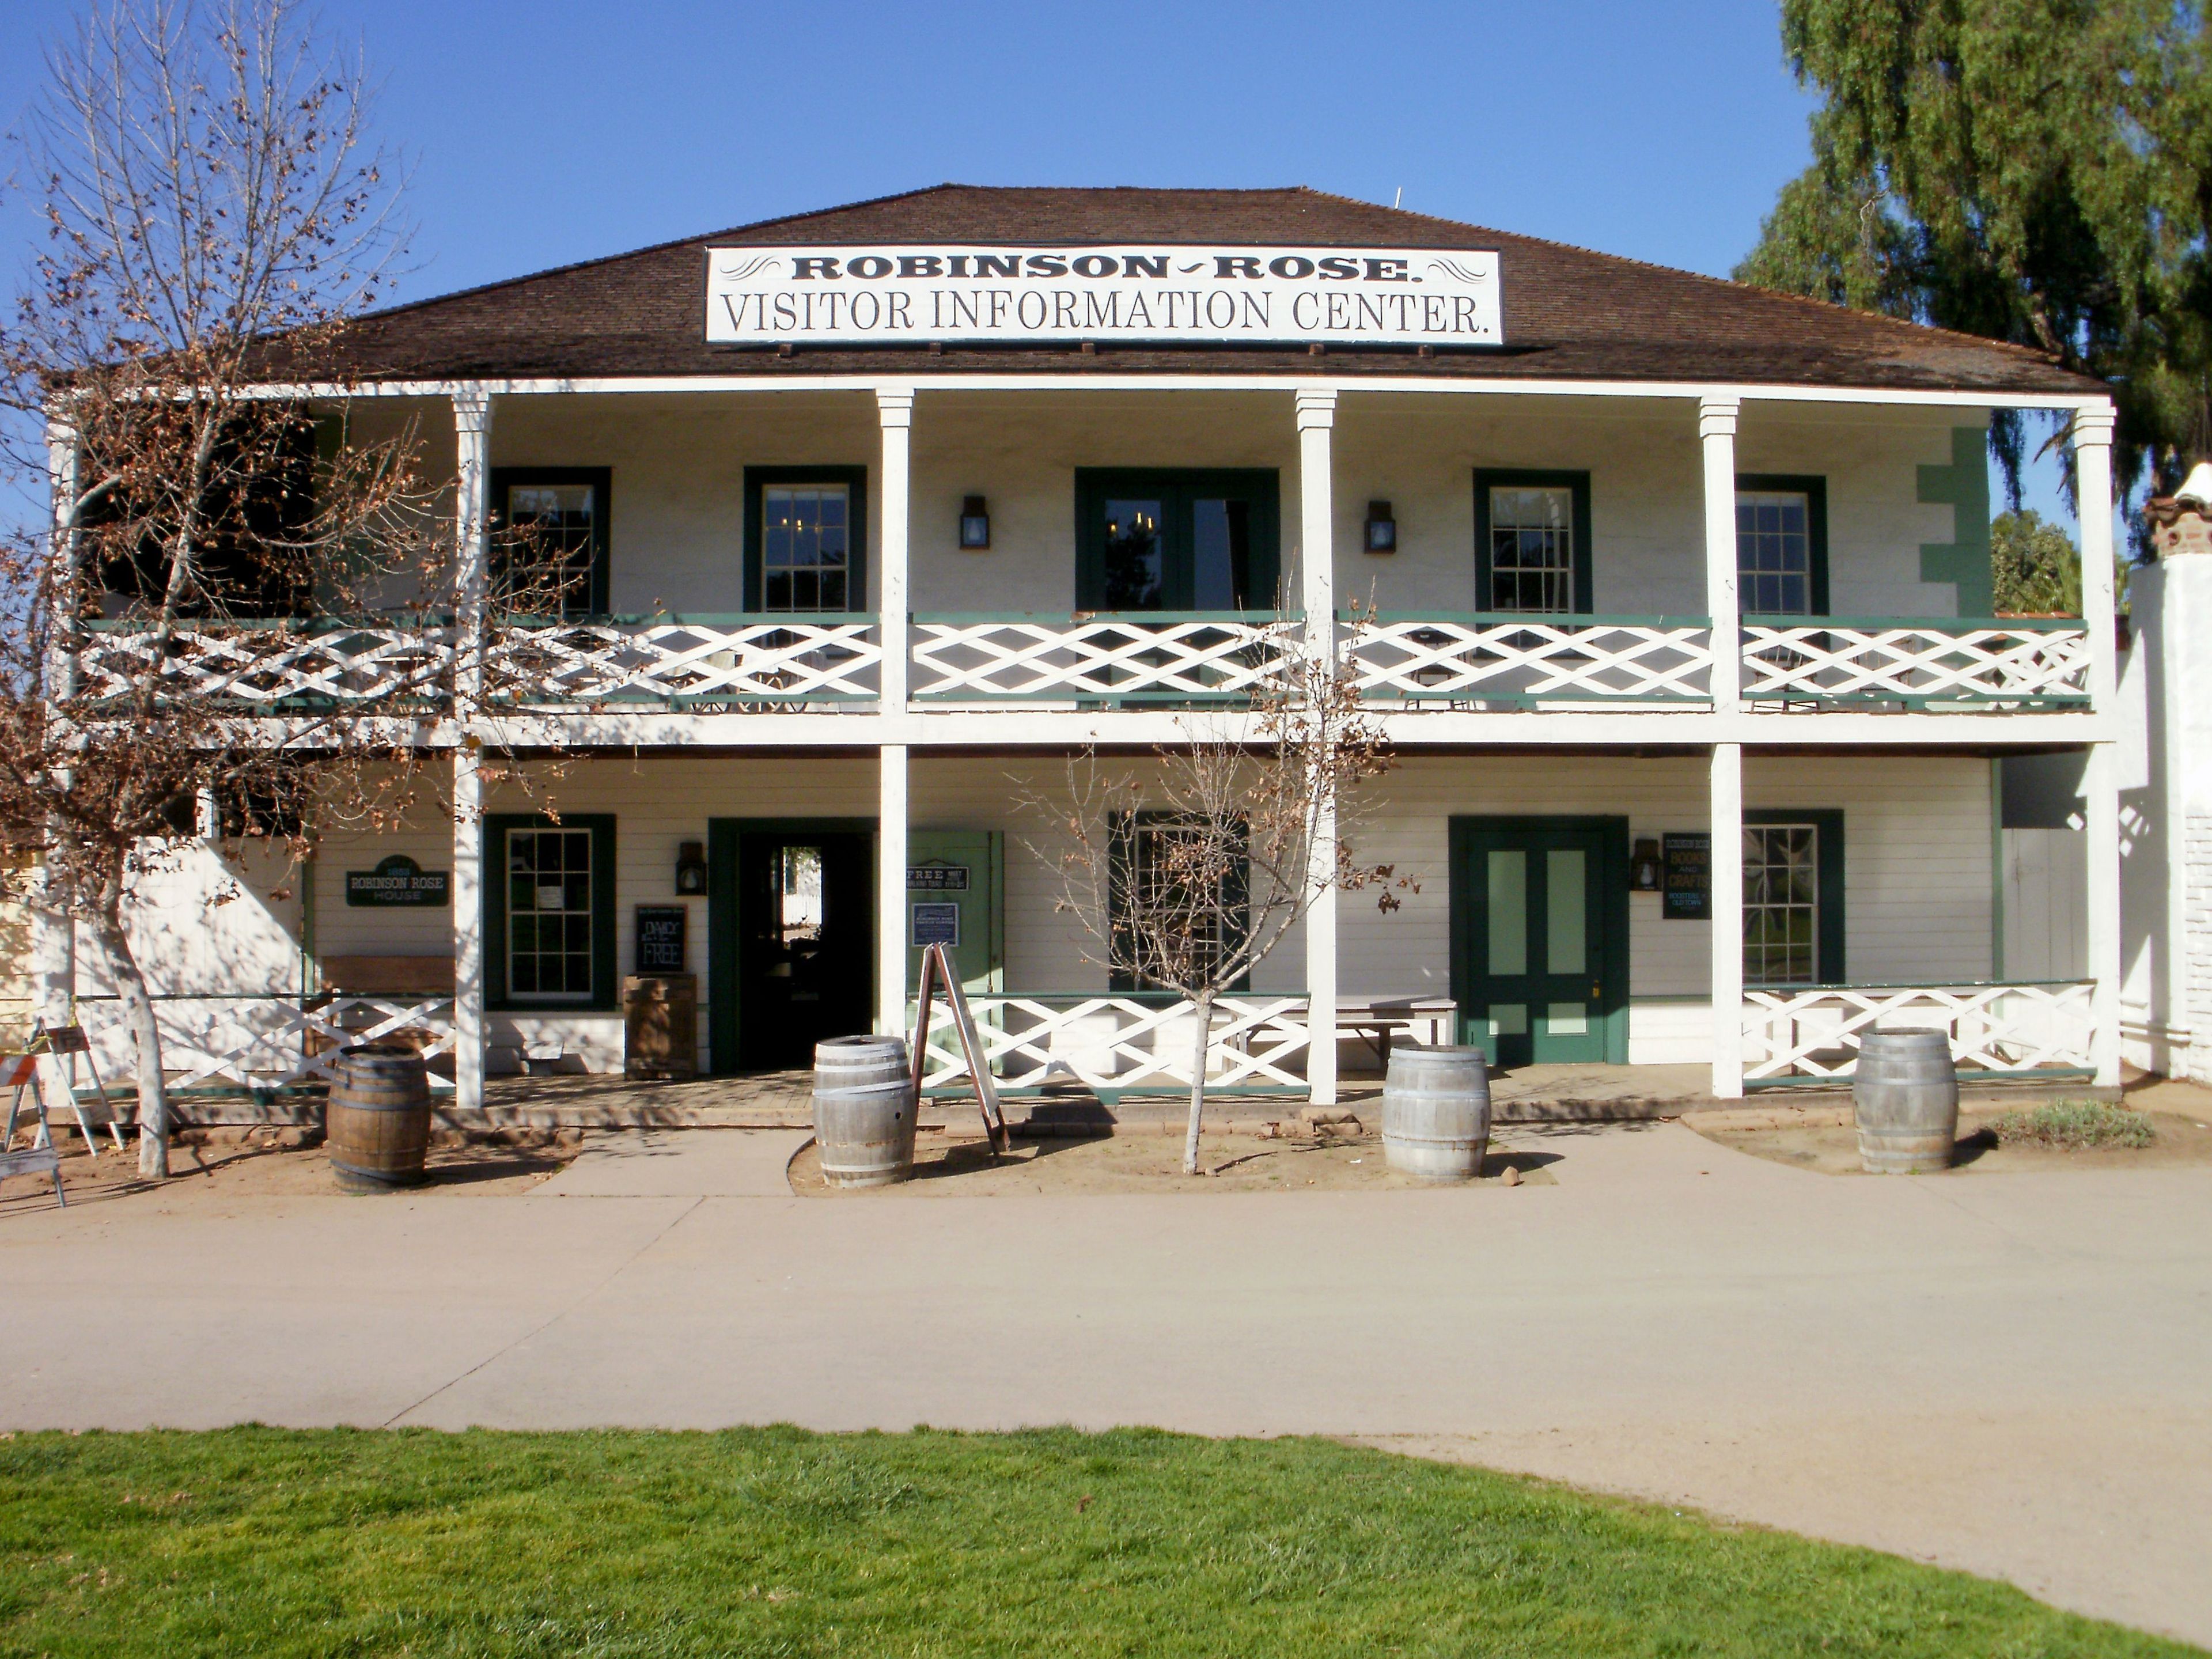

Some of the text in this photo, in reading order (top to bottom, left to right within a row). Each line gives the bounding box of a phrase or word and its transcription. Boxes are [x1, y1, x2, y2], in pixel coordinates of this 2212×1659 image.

[720, 290, 1490, 334] VISITOR INFORMATION CENTER.
[907, 870, 943, 879] FREE
[351, 877, 444, 889] ROBINSON ROSE
[373, 891, 422, 900] HOUSE
[643, 943, 680, 964] FREE
